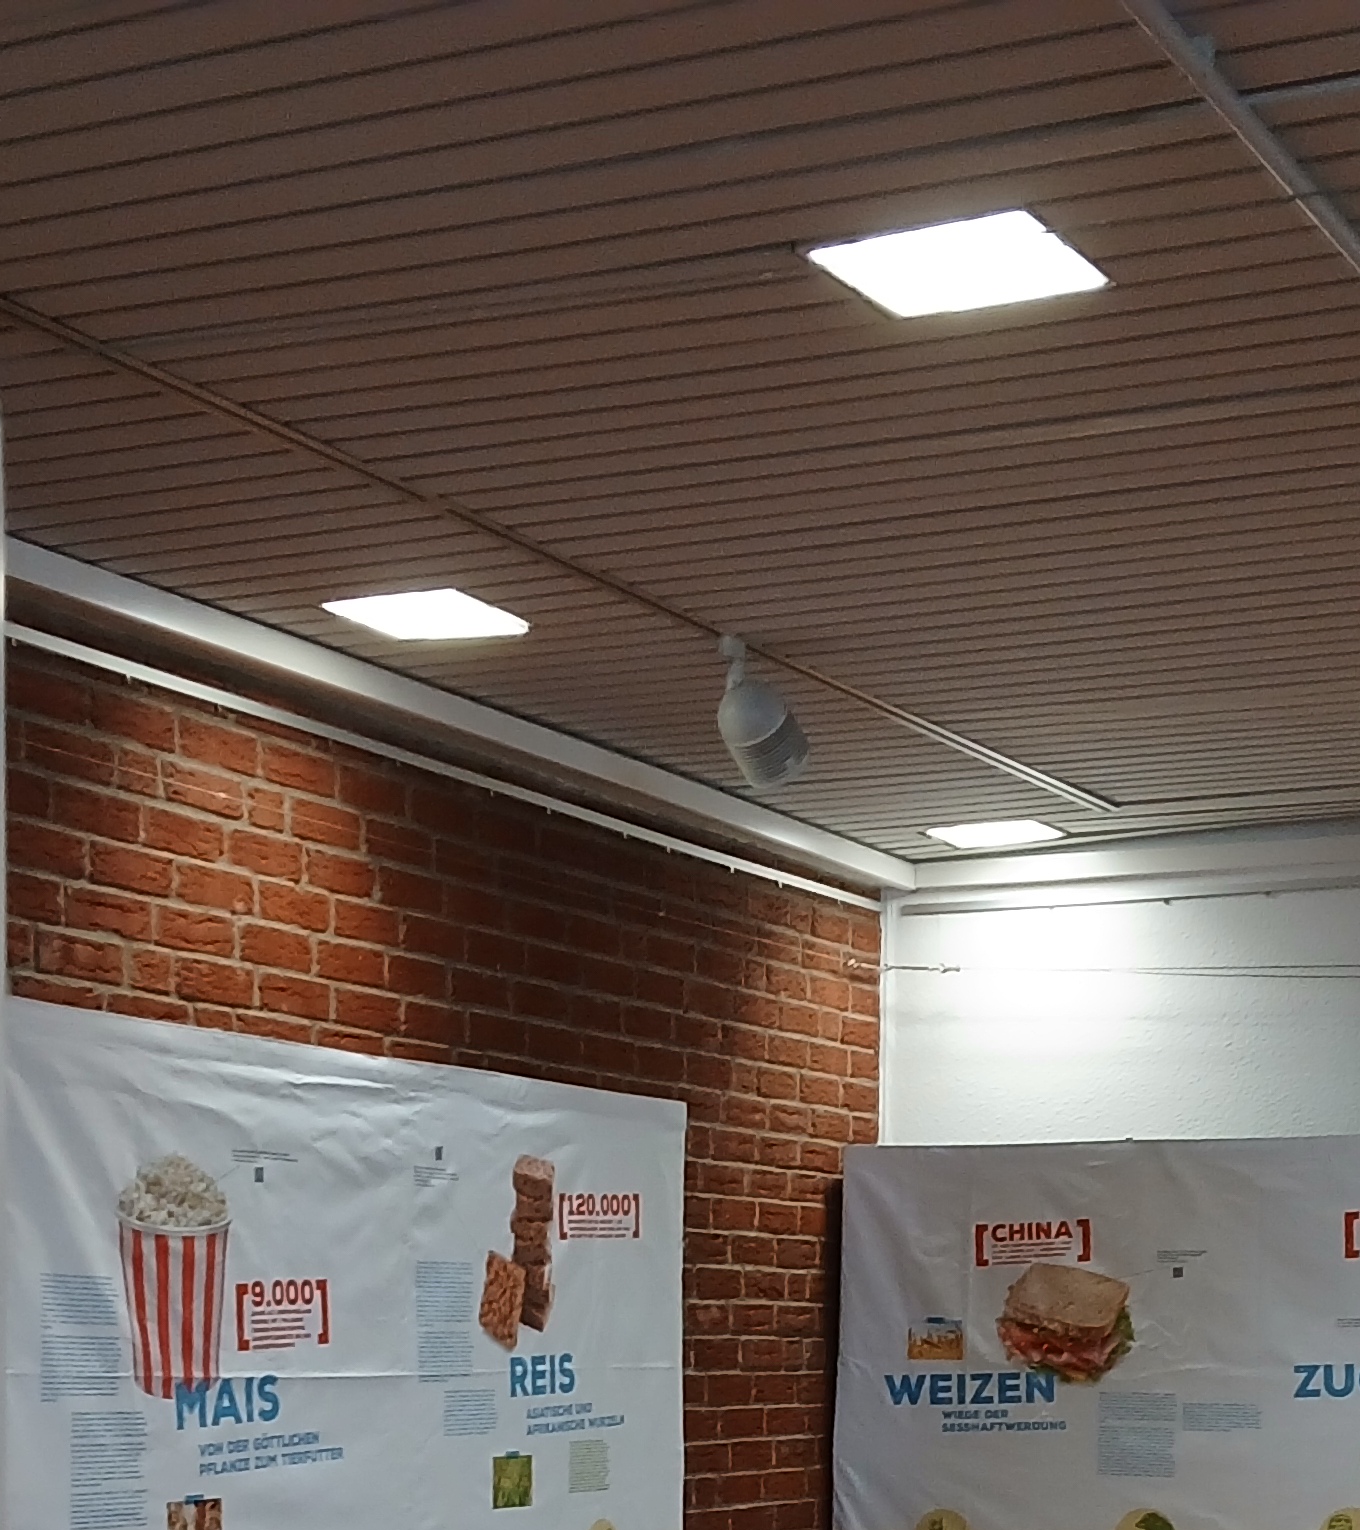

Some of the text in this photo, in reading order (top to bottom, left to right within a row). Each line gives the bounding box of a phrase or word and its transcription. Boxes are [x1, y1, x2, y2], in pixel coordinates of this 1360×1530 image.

[567, 1193, 631, 1216] 120.000
[990, 1220, 1073, 1243] CHINA
[251, 1279, 314, 1308] 9.000
[510, 1352, 576, 1398] REIS
[883, 1371, 1056, 1407] WEIZEN
[175, 1374, 280, 1431] MAIS
